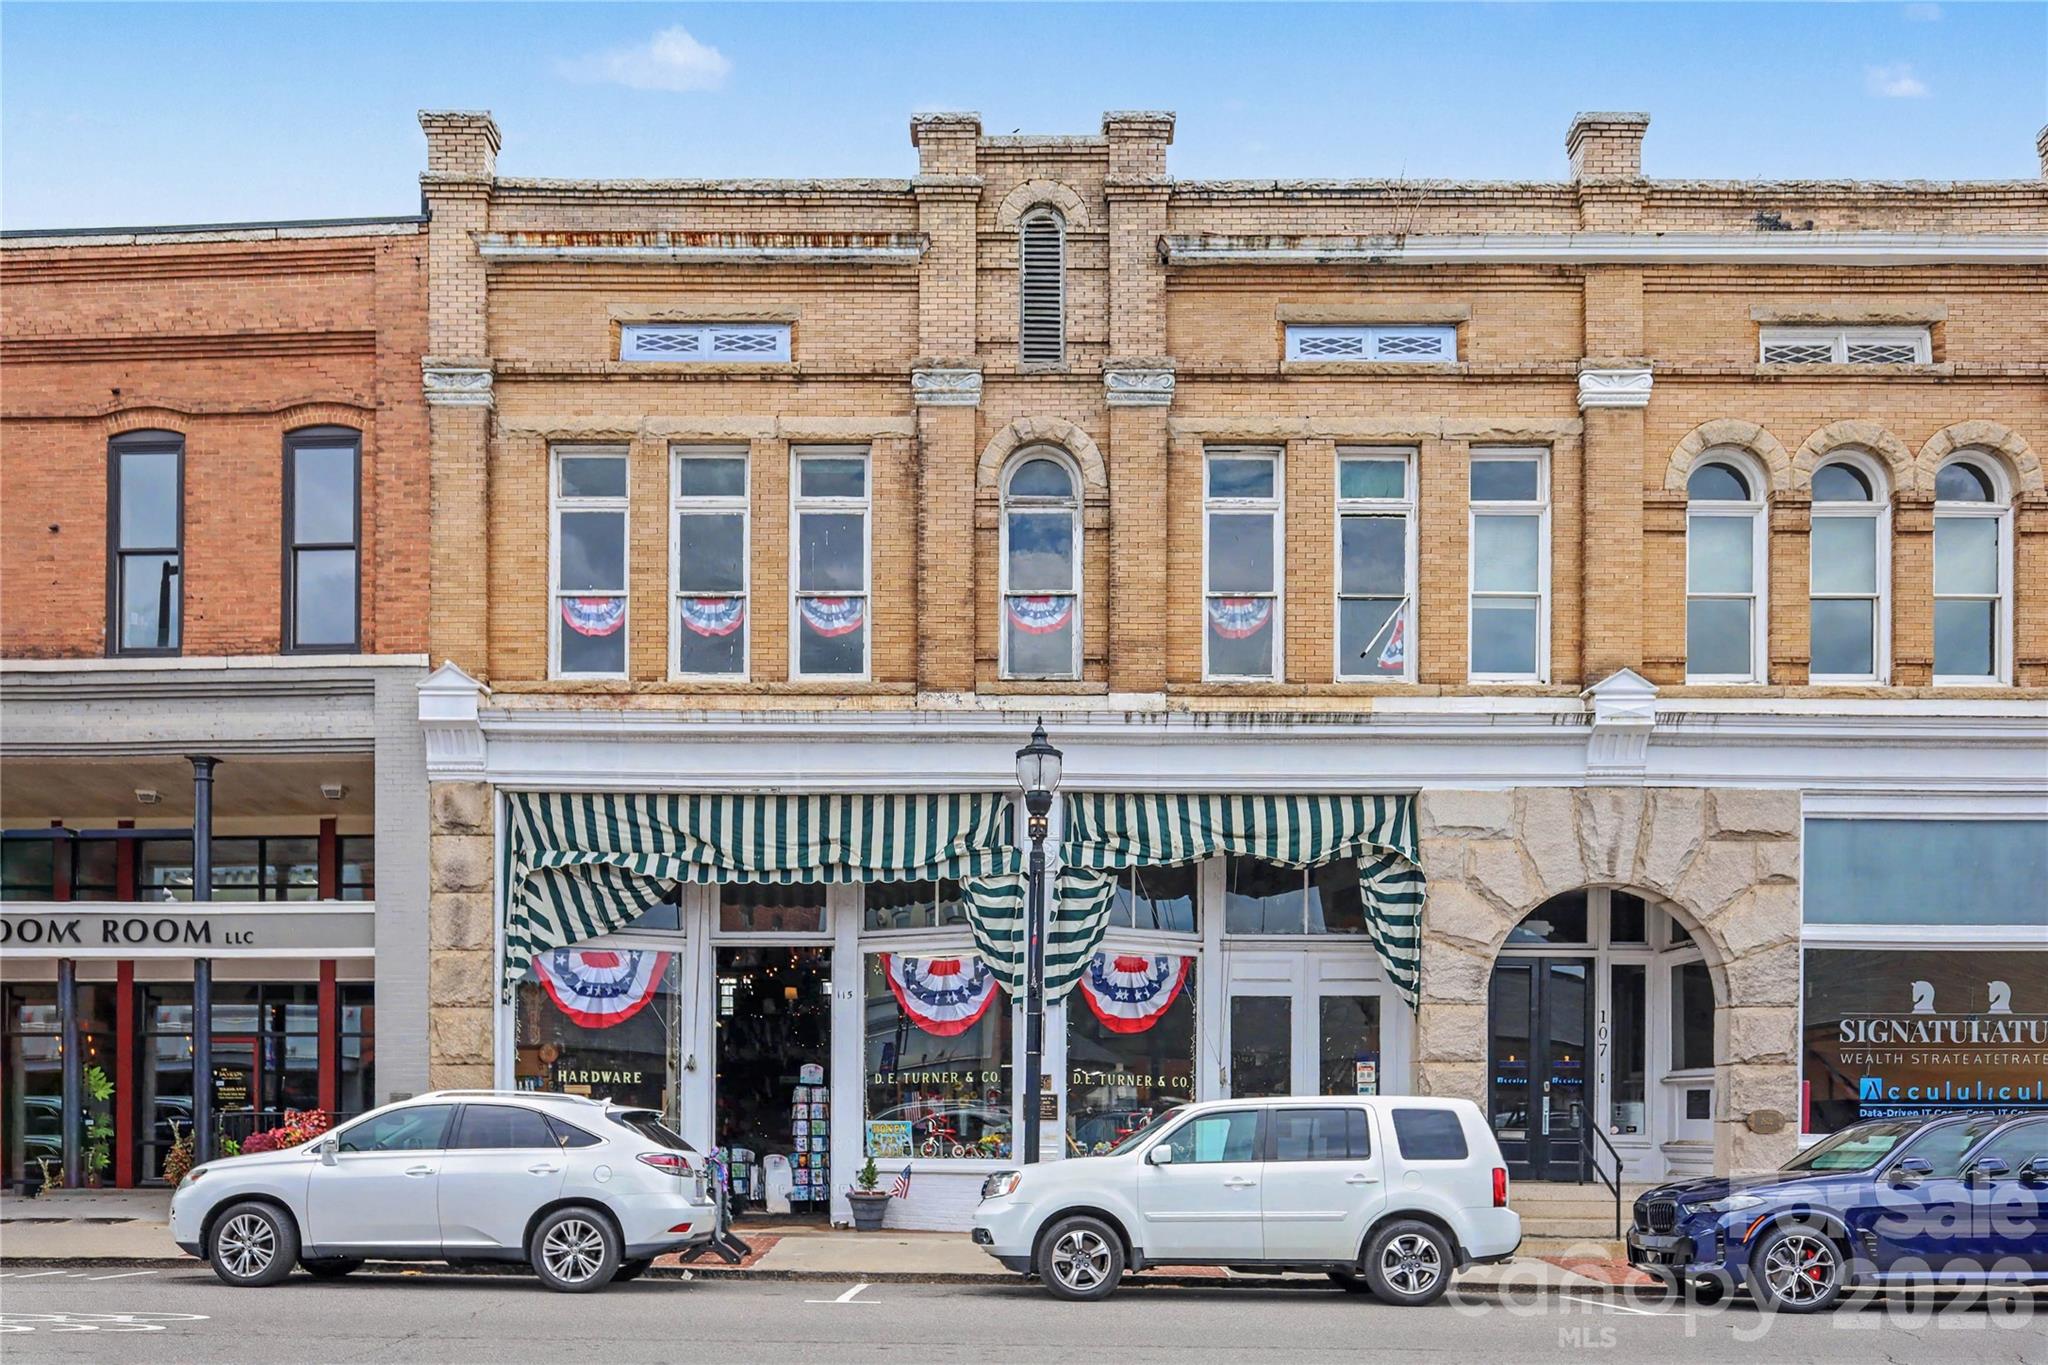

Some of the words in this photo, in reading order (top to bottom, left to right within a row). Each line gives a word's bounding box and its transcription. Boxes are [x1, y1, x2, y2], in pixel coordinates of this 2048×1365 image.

[102, 919, 212, 944] ROOM
[225, 932, 254, 945] LLC
[837, 990, 853, 1000] 115
[1840, 1053, 1903, 1065] WEALTH
[558, 1070, 642, 1084] HARDWARE
[903, 1072, 958, 1084] TURNER
[965, 1071, 975, 1083] &
[981, 1071, 1001, 1083] CO.
[1099, 1074, 1152, 1087] TURNER
[1158, 1076, 1167, 1087] &
[1172, 1076, 1190, 1088] CO.
[1859, 1108, 1919, 1118] Data-Driven
